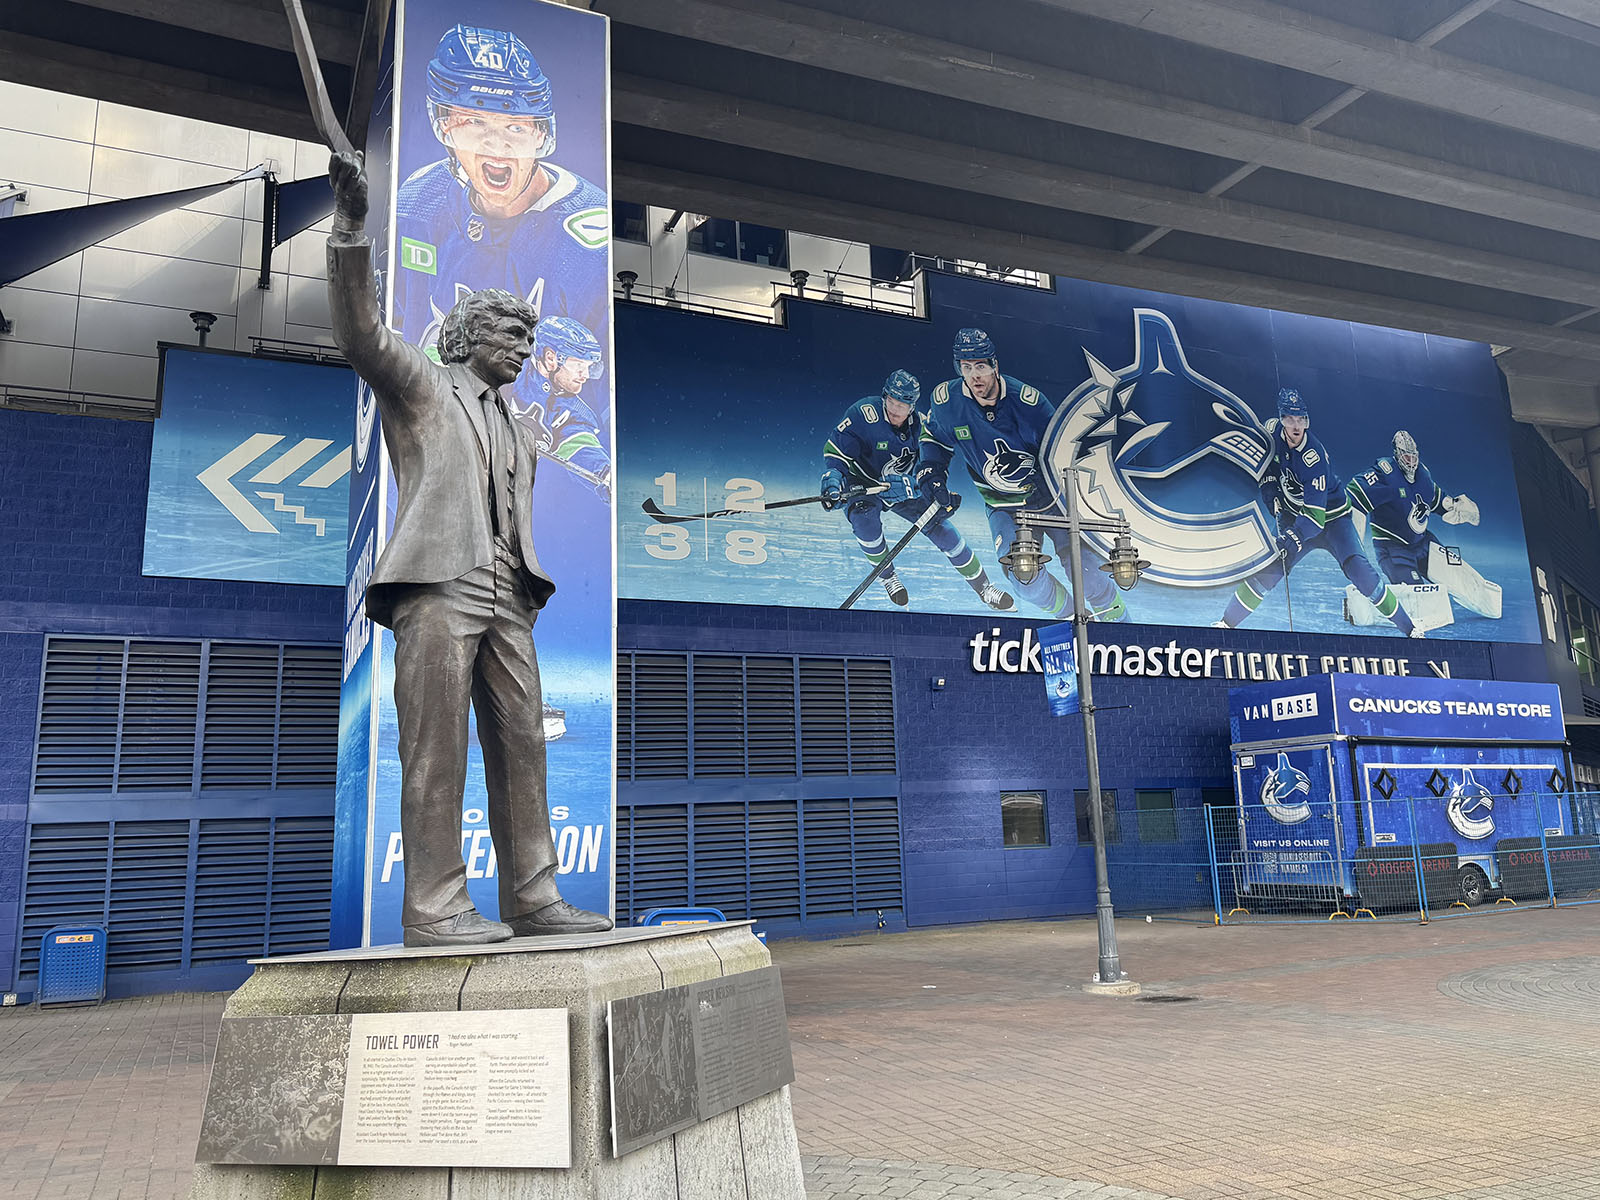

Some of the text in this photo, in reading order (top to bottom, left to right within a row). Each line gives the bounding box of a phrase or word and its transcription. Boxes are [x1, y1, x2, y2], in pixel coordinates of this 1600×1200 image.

[474, 50, 504, 71] 40
[469, 85, 514, 96] BAUER
[404, 243, 434, 267] TD
[956, 428, 970, 438] TD
[654, 472, 766, 512] 1 2
[1312, 474, 1326, 491] 40
[644, 524, 768, 565] 3 8
[1413, 585, 1439, 593] CCM
[970, 628, 1219, 678] tickmaster
[1220, 651, 1309, 681] TICKET
[1243, 698, 1312, 721] VAN BASE
[1349, 698, 1552, 718] CANUCKS TEAM STORE
[1294, 839, 1330, 847] ONLINE
[366, 1034, 440, 1050] TOWEL POWER
